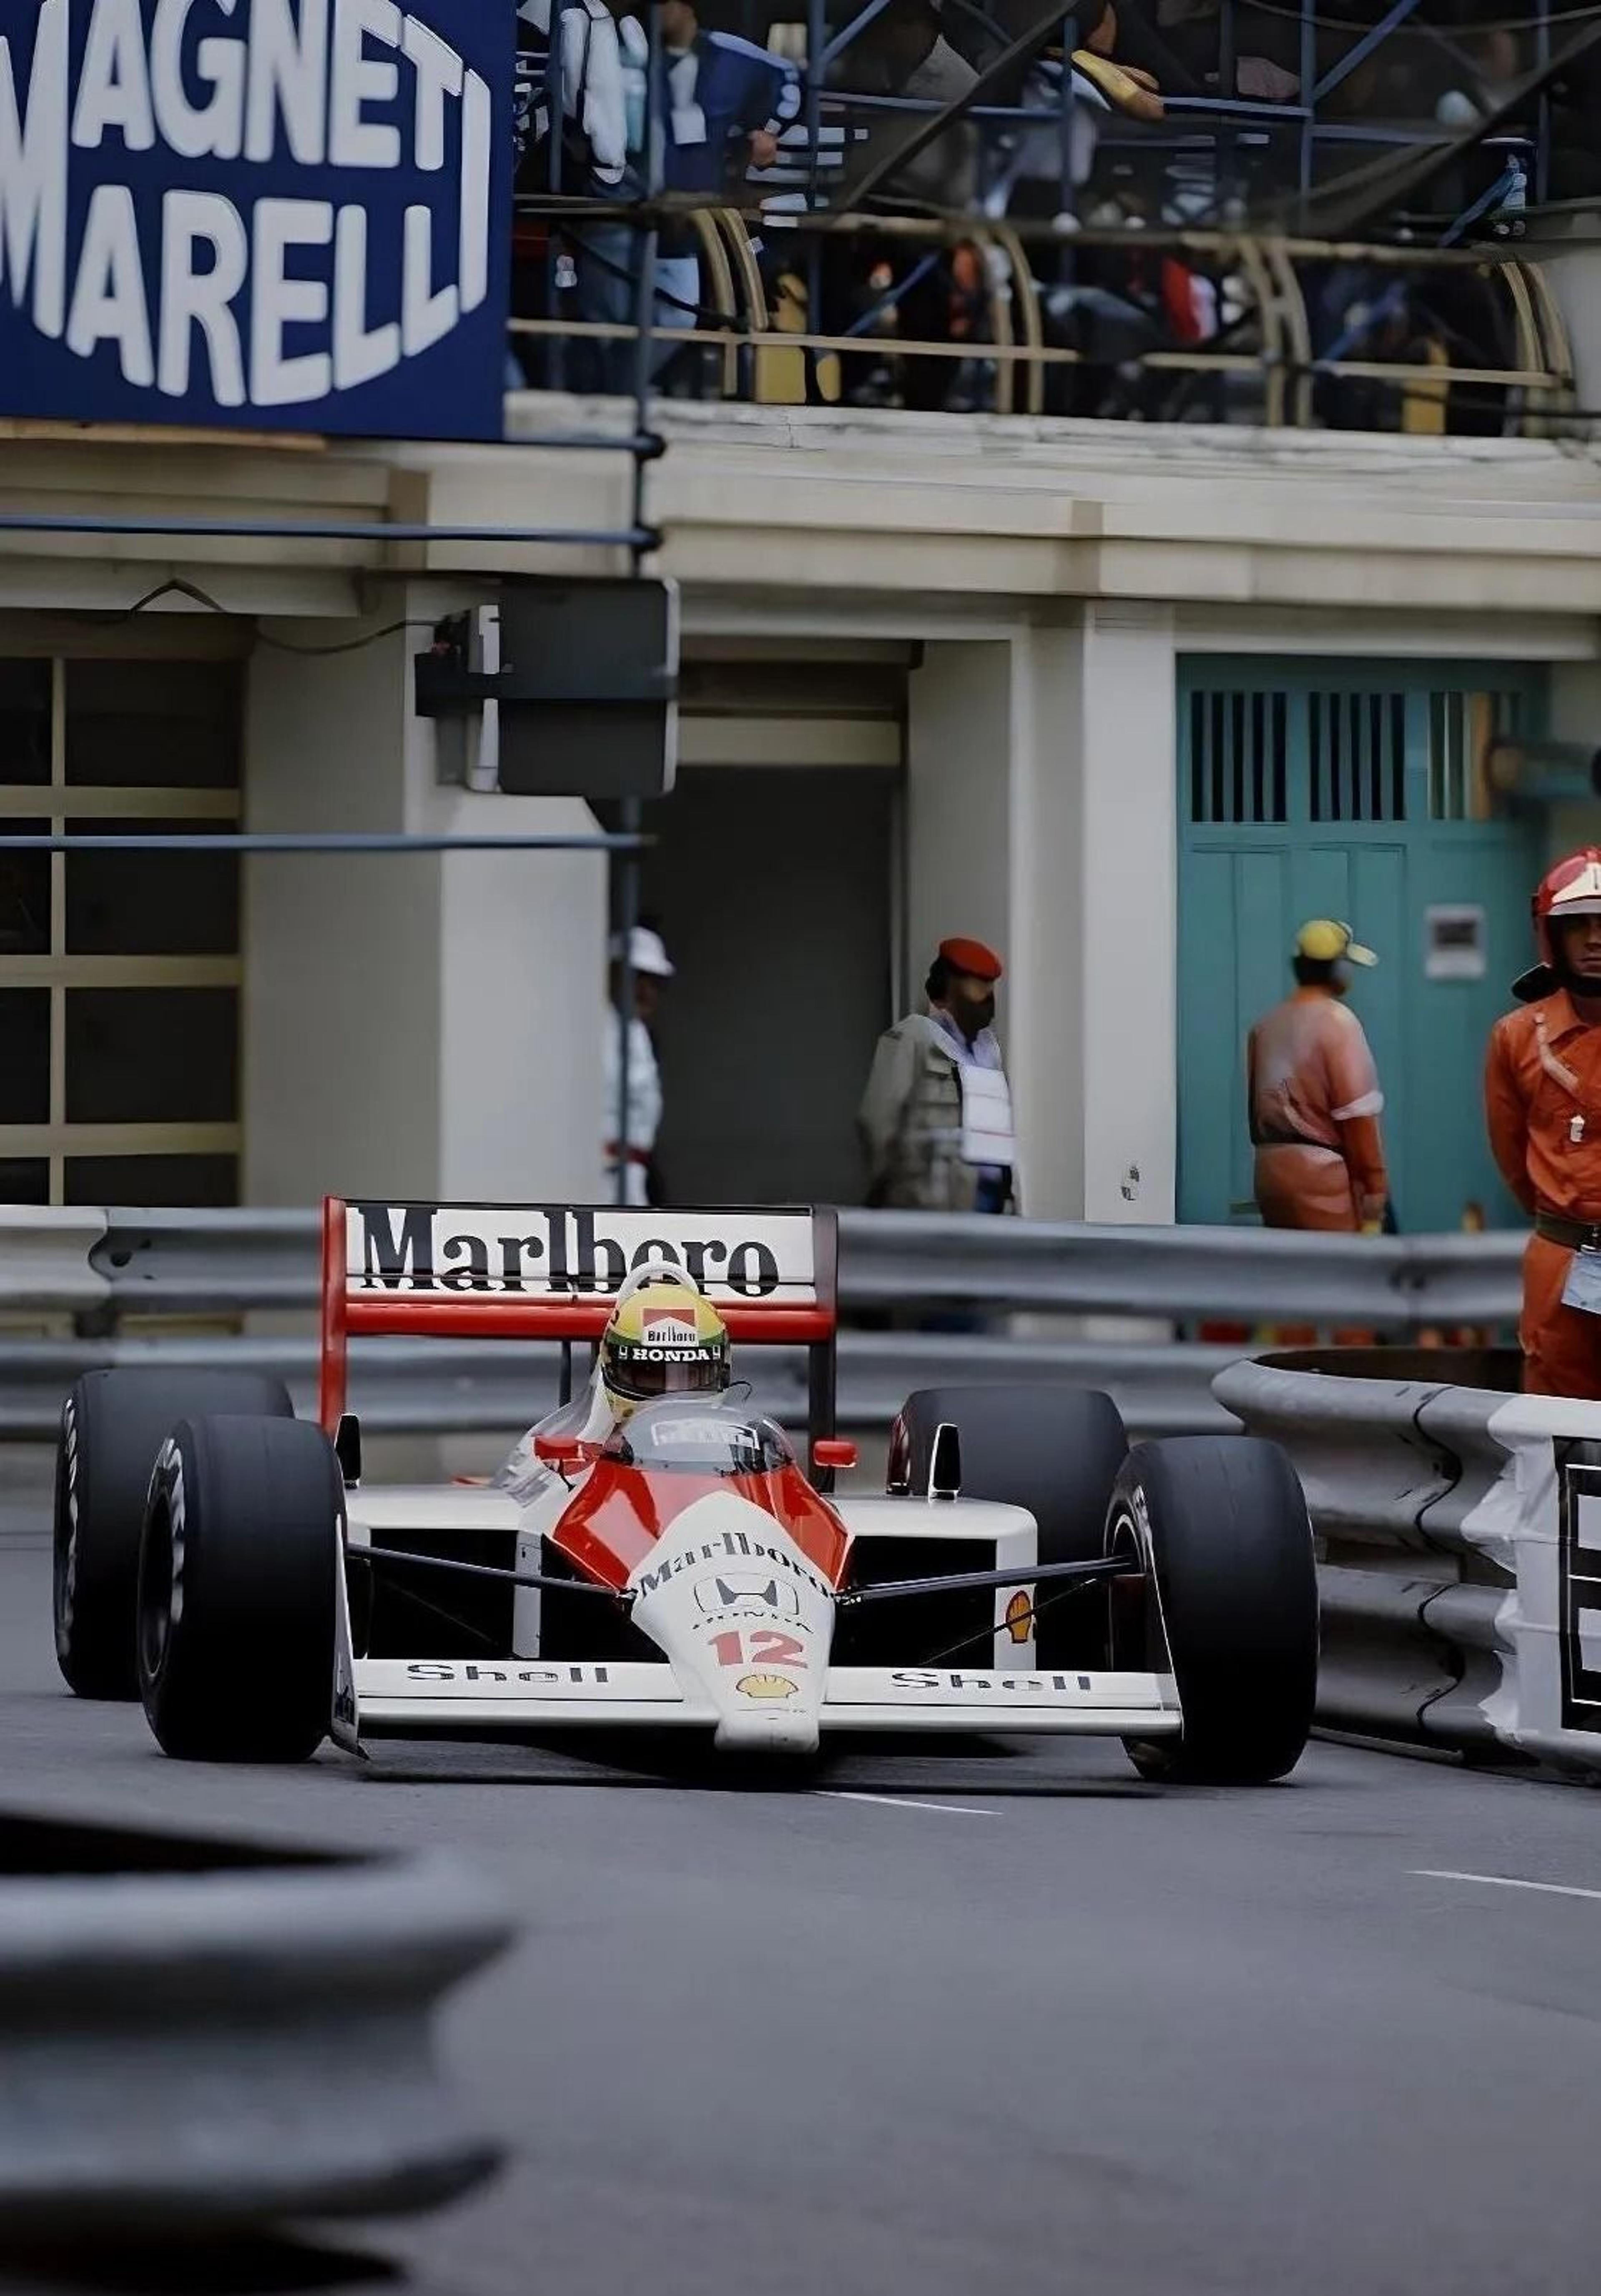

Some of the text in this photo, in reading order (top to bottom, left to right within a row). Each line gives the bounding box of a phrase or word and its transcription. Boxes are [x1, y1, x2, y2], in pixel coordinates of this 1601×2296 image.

[359, 1205, 780, 1297] Marlboro
[632, 1348, 710, 1362] HONDA
[708, 1630, 808, 1669] 12
[407, 1664, 609, 1683] Shell
[890, 1672, 1092, 1691] Shell
